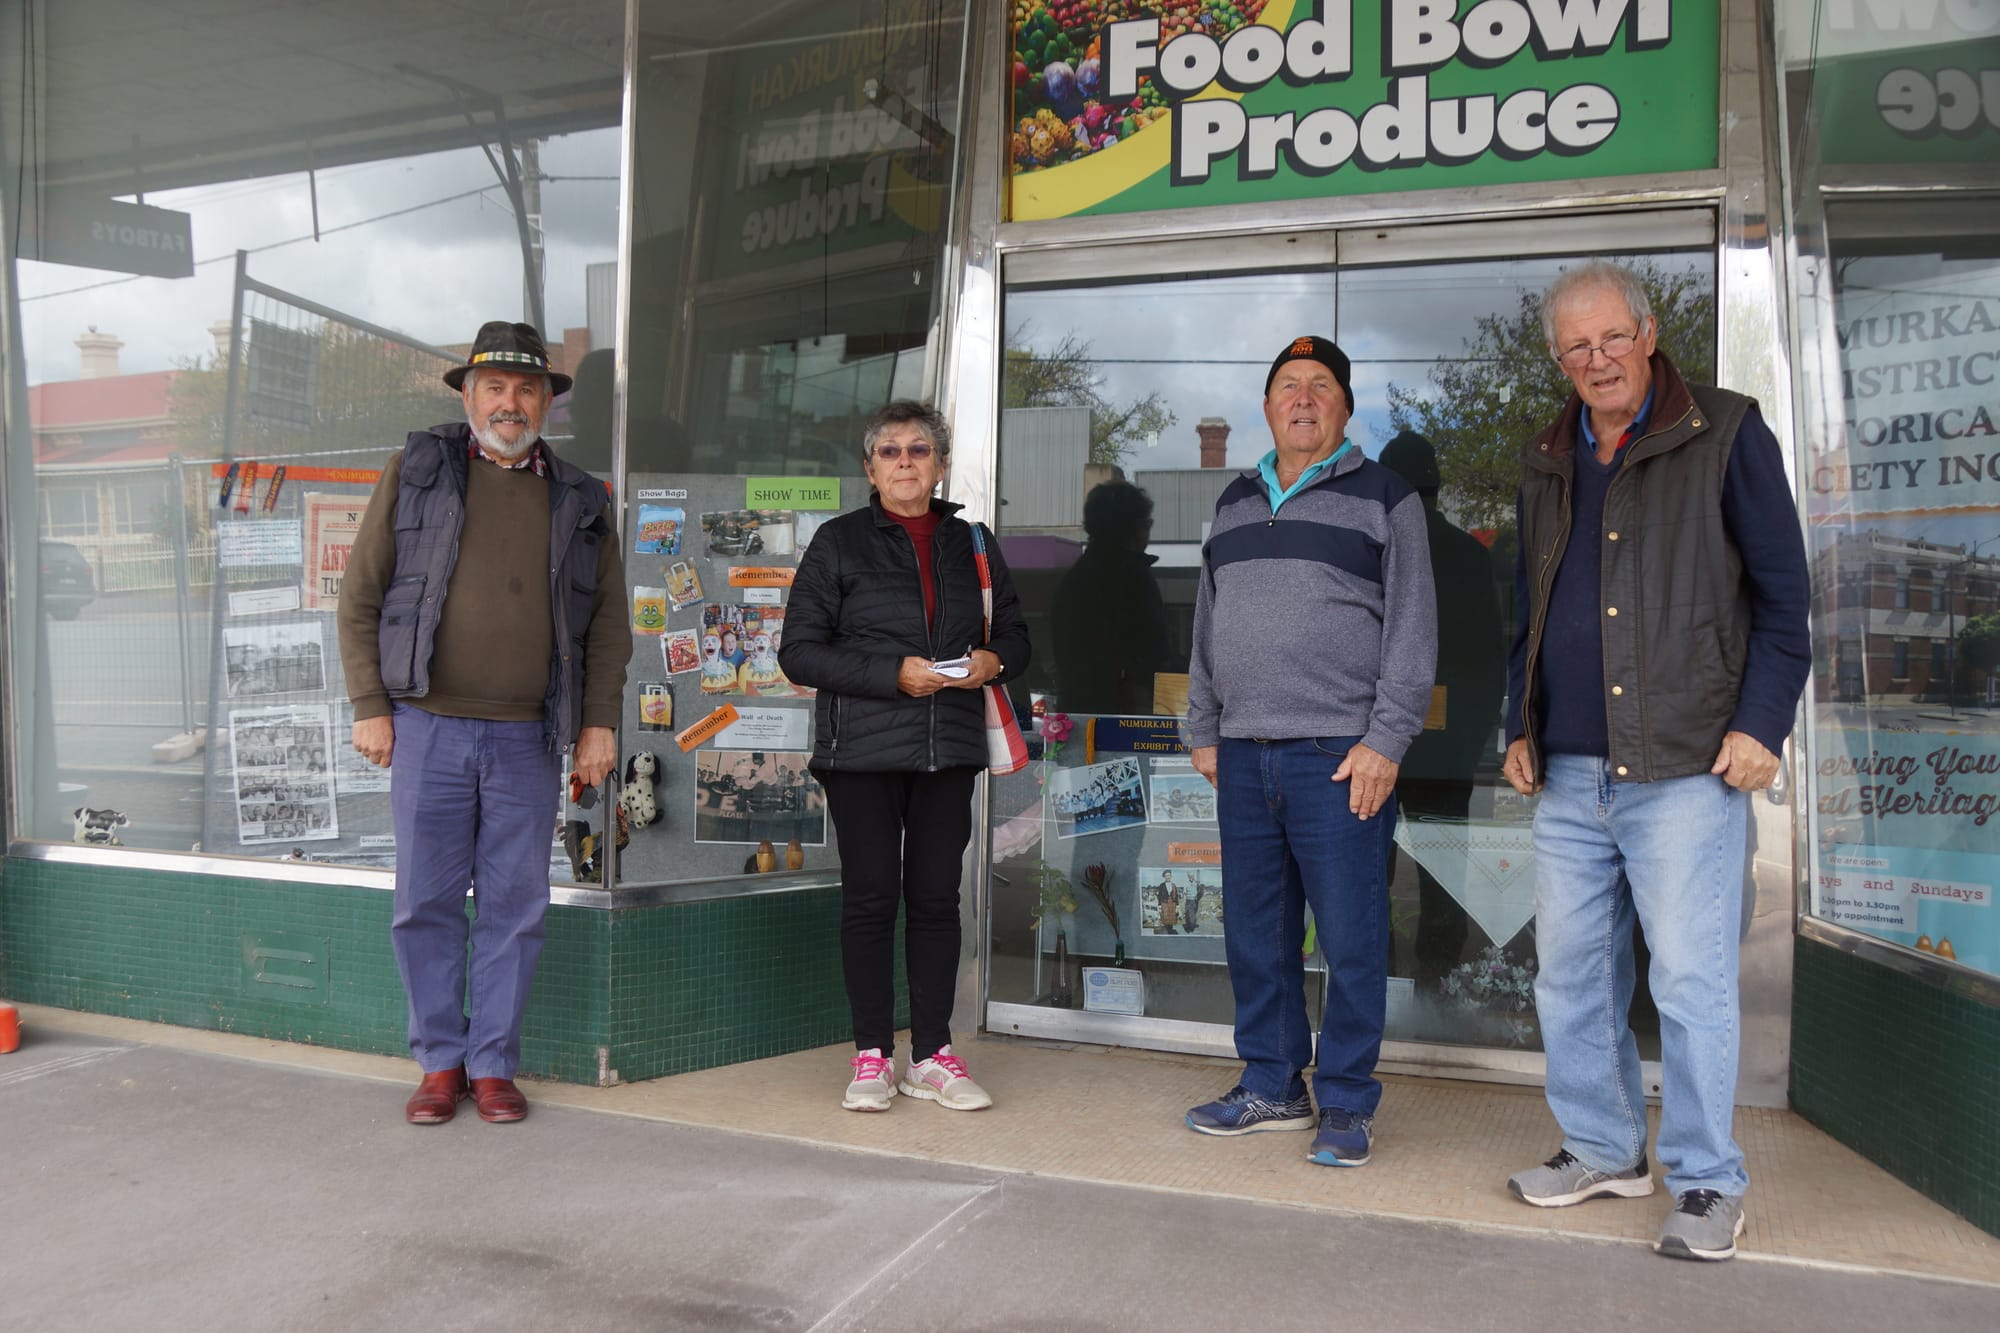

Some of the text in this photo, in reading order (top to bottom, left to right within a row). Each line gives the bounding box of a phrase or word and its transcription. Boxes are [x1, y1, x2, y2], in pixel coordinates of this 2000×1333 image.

[1107, 0, 1352, 97] Food
[1172, 76, 1620, 187] Produce
[1837, 300, 2000, 350] MURKA
[1845, 406, 2000, 447] ORICA
[336, 471, 379, 481] NUMURK
[1806, 459, 1926, 494] CIETY
[639, 490, 686, 499] Show Bags
[754, 488, 832, 501] SHOW TIME
[321, 544, 354, 572] ANN
[735, 570, 788, 580] Remember
[321, 577, 343, 595] TU
[766, 714, 784, 722] Death
[1118, 719, 1173, 729] NUMURKAH
[681, 710, 729, 745] Remember
[1133, 741, 1184, 752] EXHIBIT IN
[1860, 784, 2000, 827] Heritag
[1828, 855, 1840, 865] We
[1863, 878, 1894, 891] and
[1911, 882, 1984, 902] Sundays
[1853, 898, 1863, 908] to
[1865, 900, 1900, 912] 3.30pm
[1831, 909, 1842, 919] by
[1844, 911, 1905, 926] appointment
